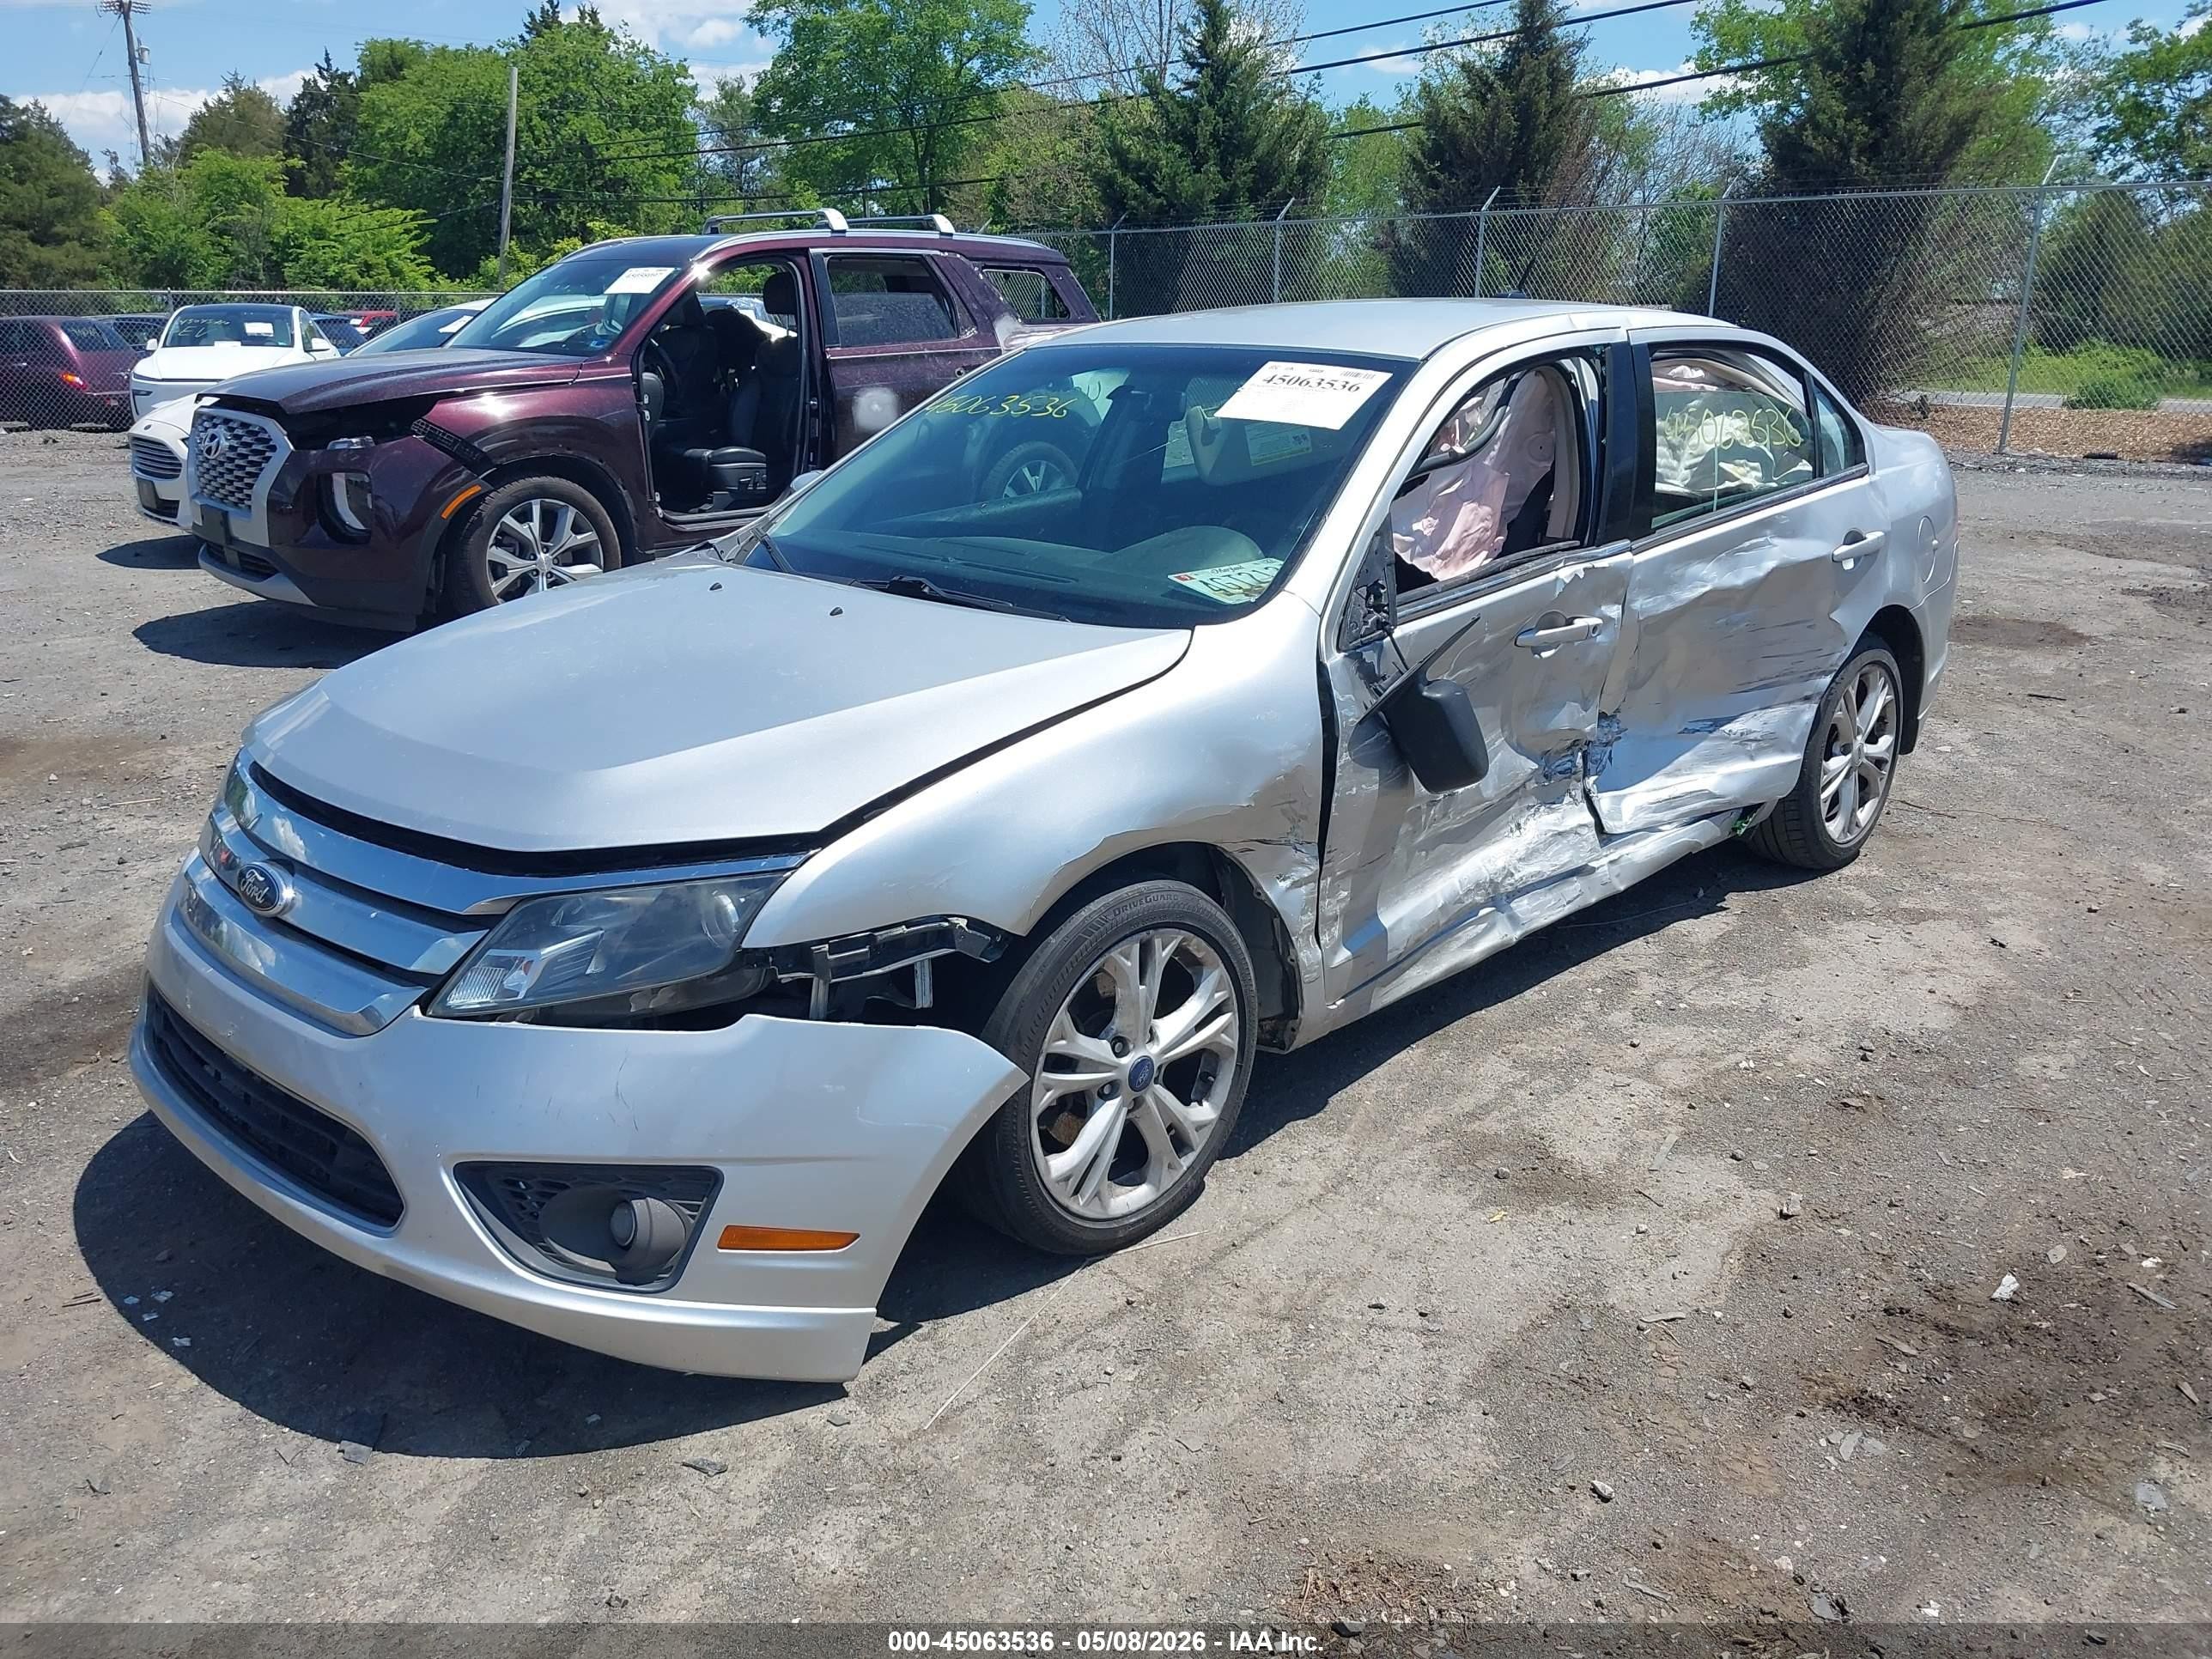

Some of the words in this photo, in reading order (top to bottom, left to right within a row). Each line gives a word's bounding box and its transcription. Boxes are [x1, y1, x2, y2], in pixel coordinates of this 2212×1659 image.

[1262, 374, 1364, 393] 45063536
[925, 394, 1078, 418] 45063536
[240, 868, 270, 904] Ford
